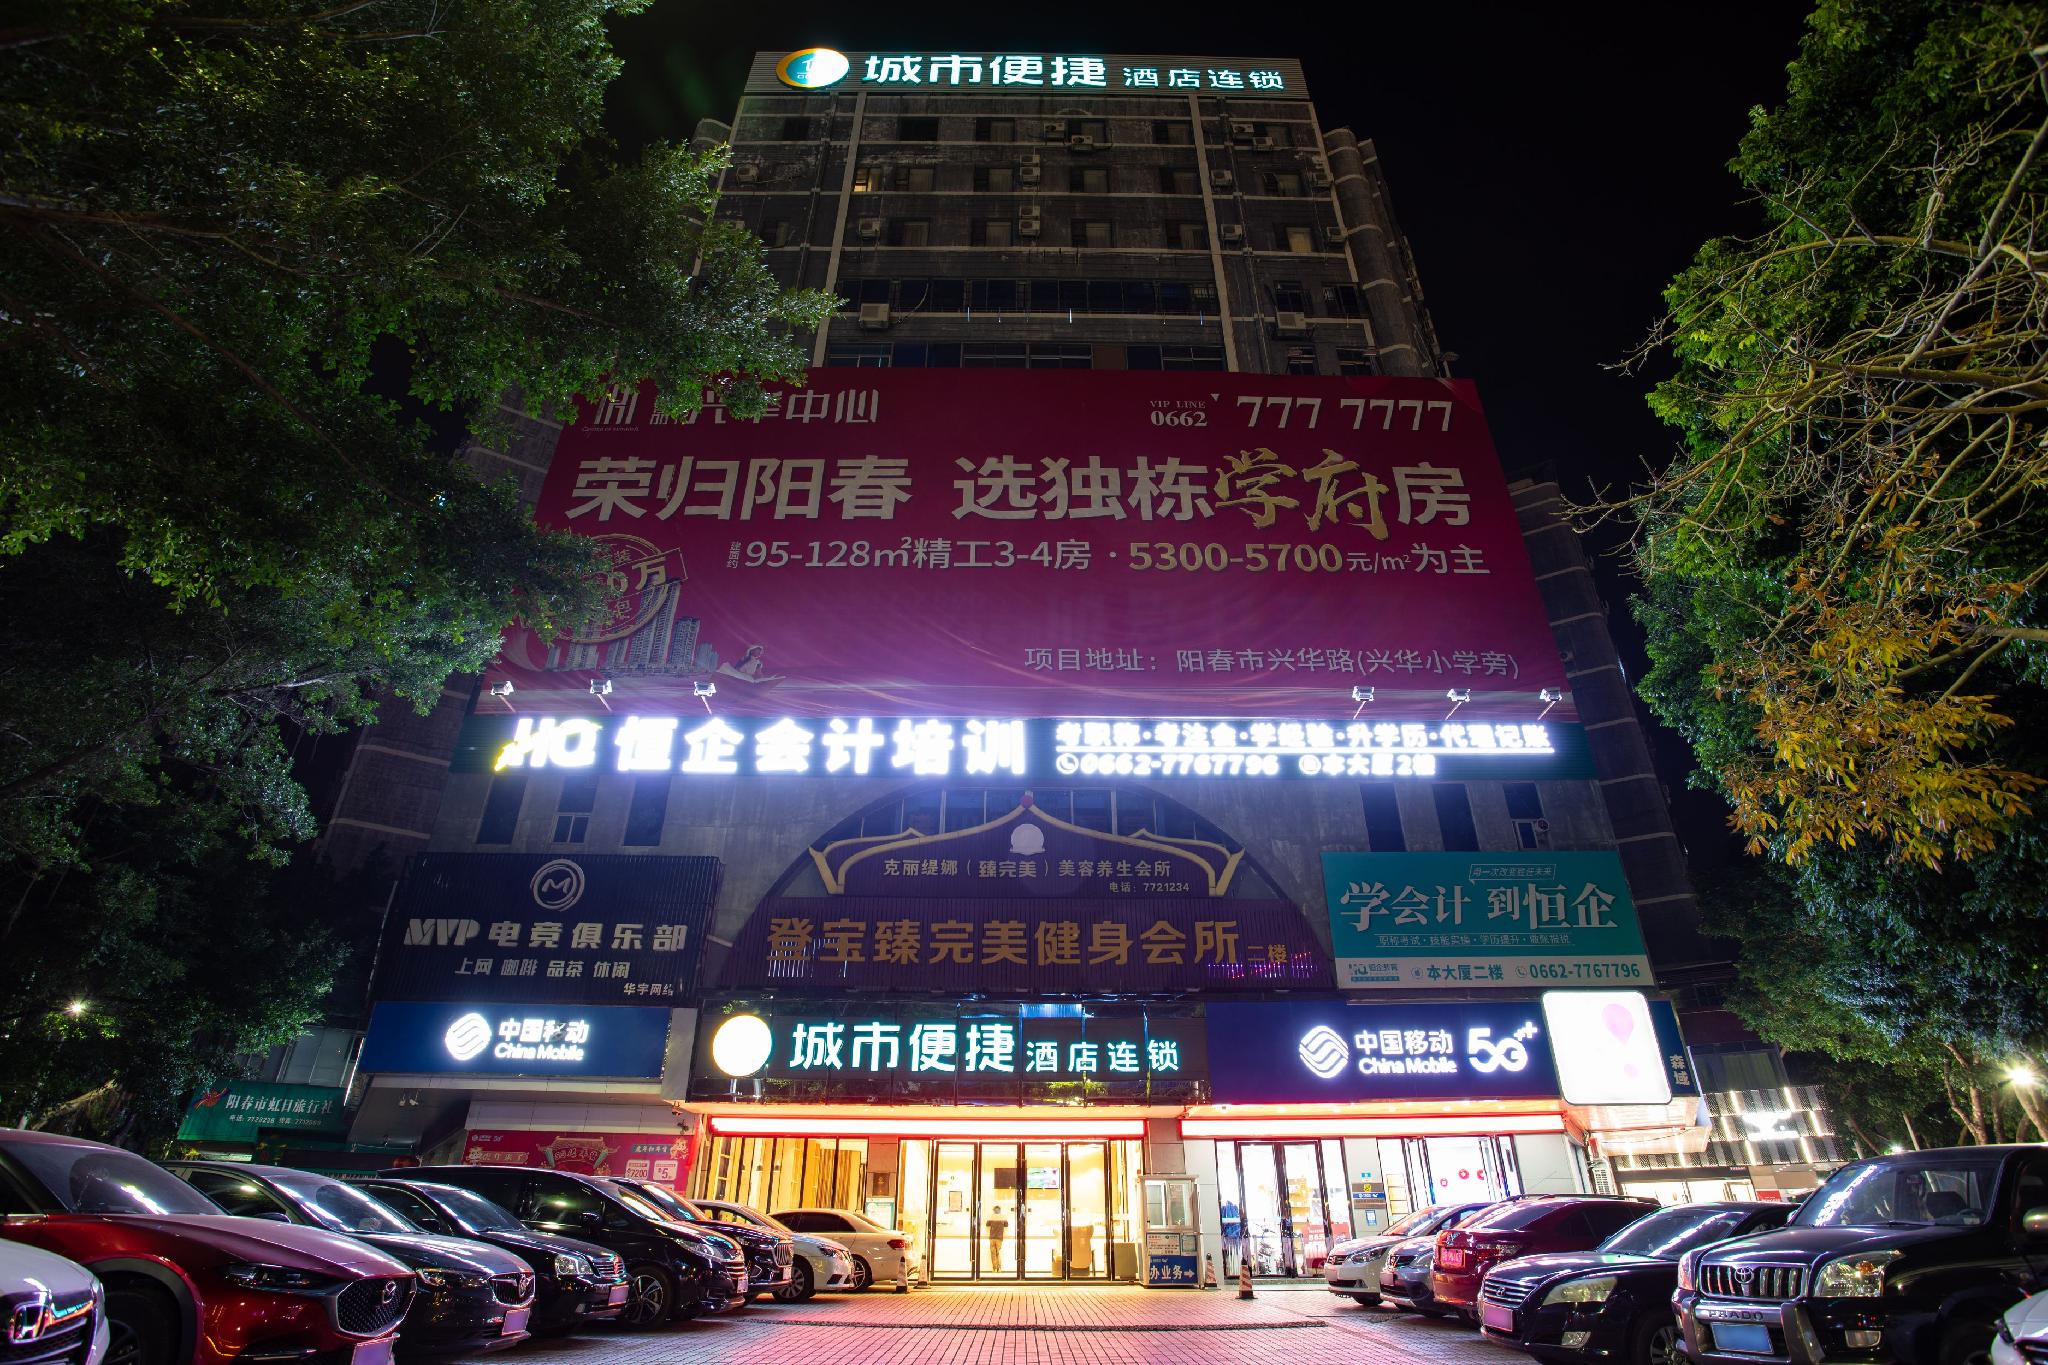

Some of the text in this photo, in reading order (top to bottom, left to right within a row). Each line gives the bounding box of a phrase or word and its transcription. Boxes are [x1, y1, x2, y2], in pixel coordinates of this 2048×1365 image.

[863, 54, 1284, 90] 城市便捷 酒店连锁
[1177, 401, 1206, 409] LINE
[1237, 396, 1452, 431] 777 7777
[1150, 410, 1208, 427] 0662
[565, 447, 1471, 540] 荣归阳春 选独栋学府房
[615, 716, 1026, 774] 恒企会计培训
[1080, 754, 1279, 775] 0662-7767796
[1339, 880, 1618, 932] 学会计 到恒企
[404, 918, 481, 946] MVP
[488, 920, 688, 951] 电竞俱乐部
[766, 918, 1240, 965] 登宝臻完美健身会所
[1247, 943, 1288, 964] 二楼
[455, 957, 631, 978] 上网 咖啡 品茶 休闲
[1426, 964, 1505, 982] 本大厦二楼
[1529, 963, 1640, 979] 0662-7767796
[623, 982, 674, 996] 华宇网络
[498, 1017, 590, 1044] 中国移动
[1354, 1029, 1454, 1055] 中国移动
[494, 1043, 584, 1061] China Mobile
[790, 1021, 1180, 1072] 城市便捷 酒店连锁
[1358, 1056, 1458, 1074] China Mobile
[1150, 1264, 1182, 1280] 办业务
[1708, 1309, 1764, 1321] PRADO
